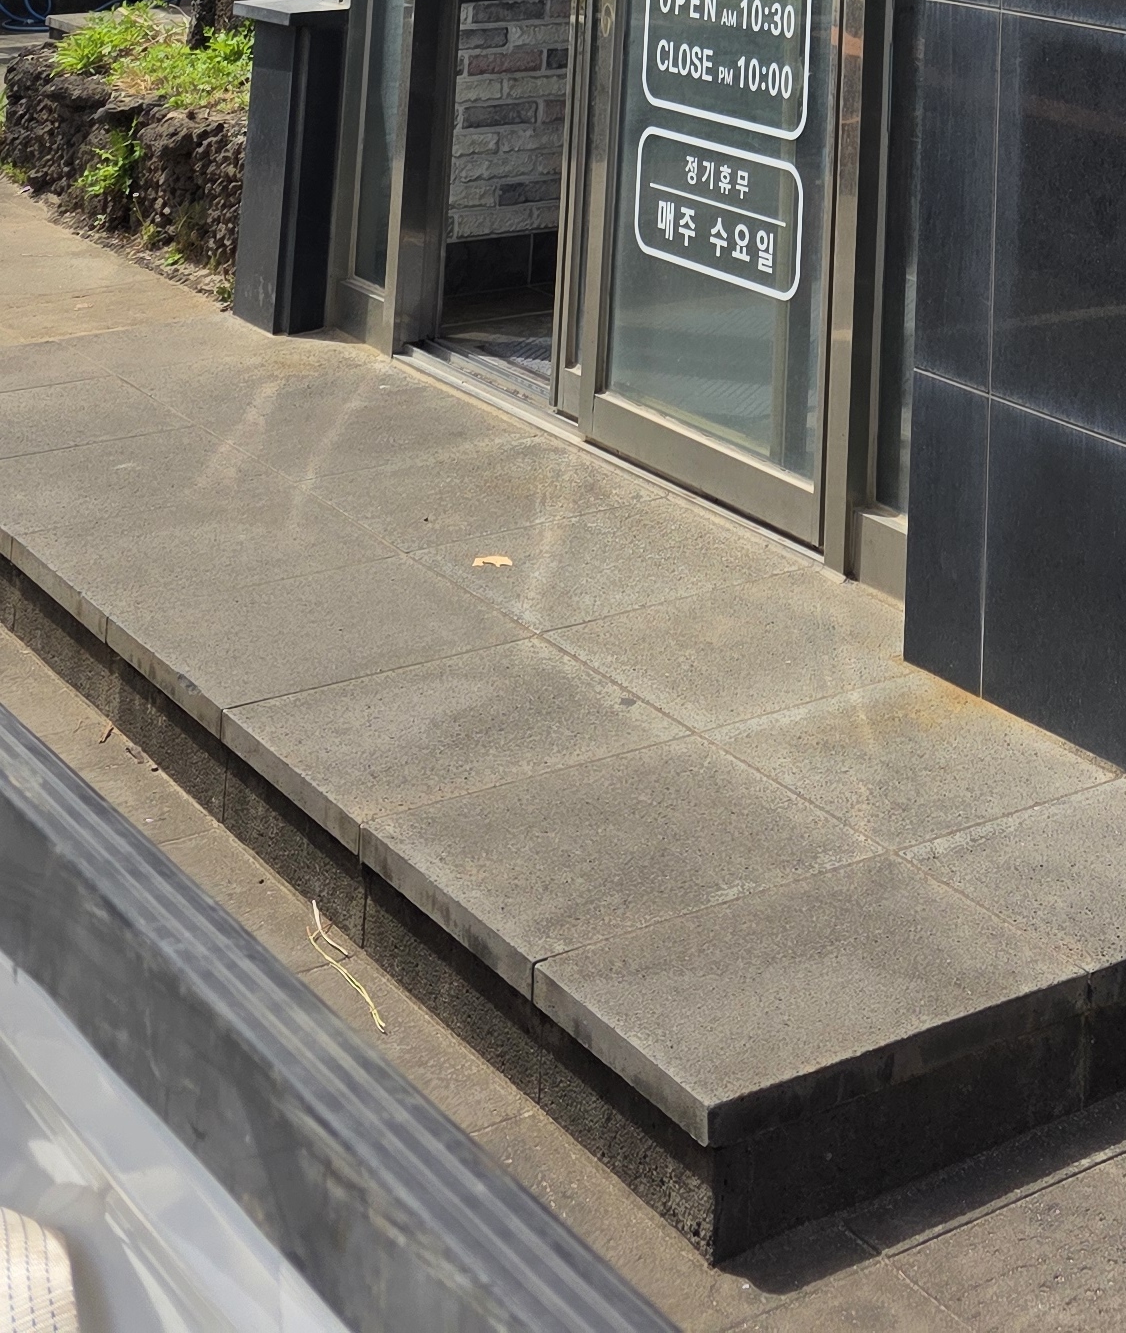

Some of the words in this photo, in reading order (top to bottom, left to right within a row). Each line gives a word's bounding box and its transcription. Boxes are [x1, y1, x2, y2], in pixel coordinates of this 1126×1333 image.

[720, 7, 737, 29] AM
[656, 39, 714, 83] CLOSE
[717, 65, 734, 87] PM
[736, 56, 793, 100] 10:00
[685, 155, 749, 200] 정기휴무
[656, 199, 696, 248] 매주
[709, 217, 775, 274] 수요일
